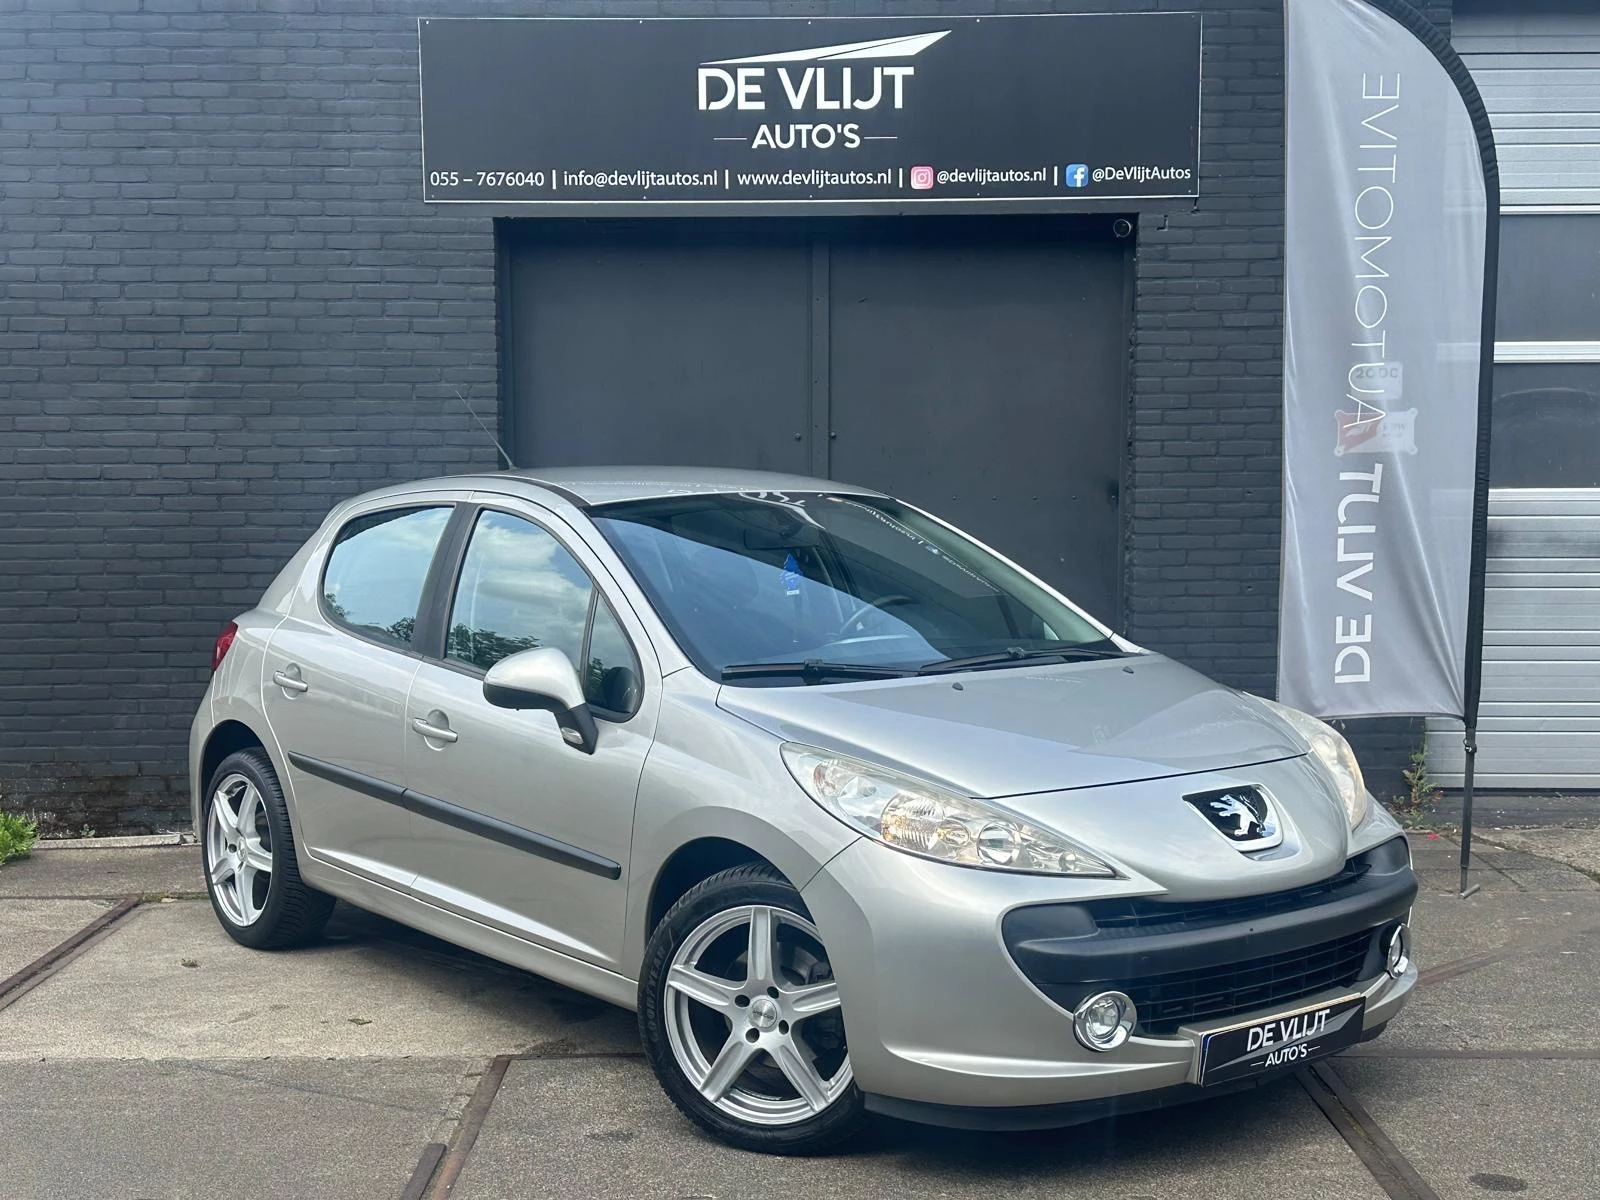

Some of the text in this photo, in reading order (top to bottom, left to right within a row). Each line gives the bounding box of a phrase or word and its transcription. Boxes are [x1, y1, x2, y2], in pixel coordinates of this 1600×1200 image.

[697, 66, 915, 111] DE VLIJT
[751, 123, 861, 149] AUTO'S
[430, 171, 459, 187] 055
[476, 171, 545, 187] 7676040
[563, 169, 718, 190] info@devlijtautos.nl
[736, 168, 892, 189] www.devlijtautos.nl
[936, 167, 1047, 186] @devlijtautos.nl
[1092, 165, 1191, 183] @DeVlijtAutos
[1246, 1008, 1331, 1052] DE VLIJT
[1264, 1042, 1308, 1068] AUTO'S
